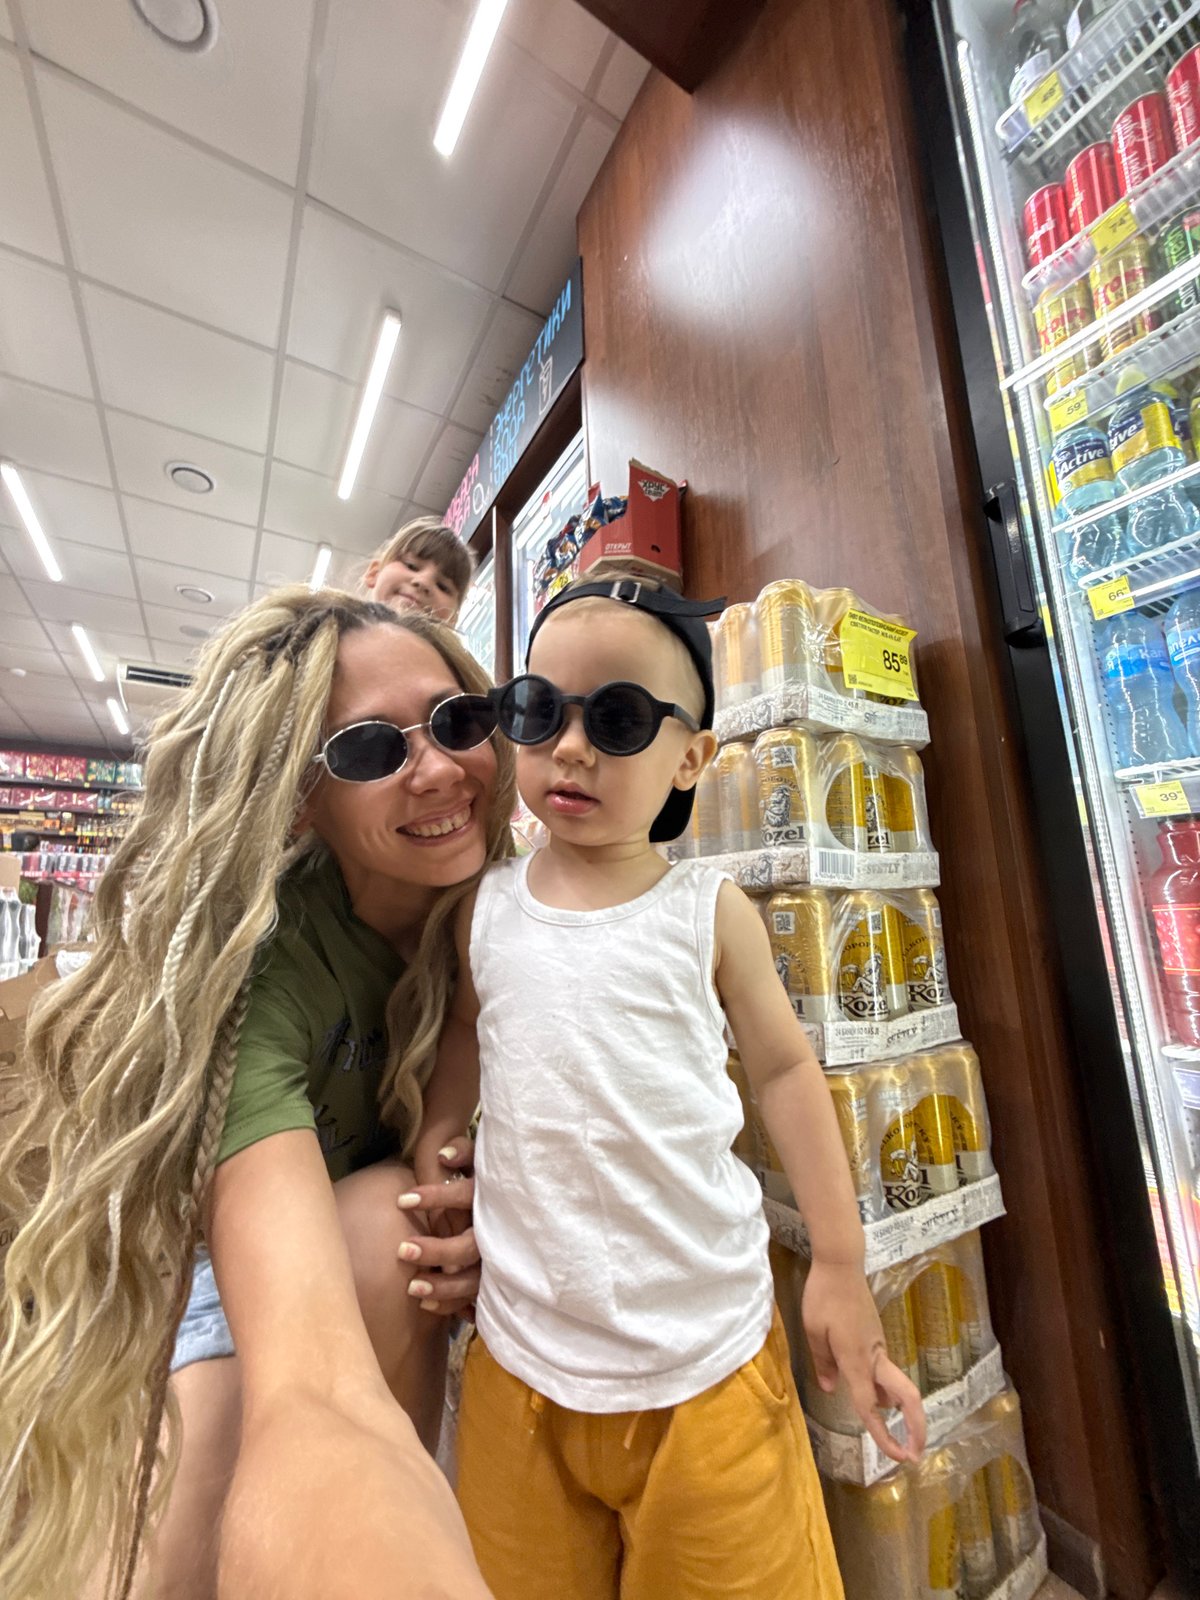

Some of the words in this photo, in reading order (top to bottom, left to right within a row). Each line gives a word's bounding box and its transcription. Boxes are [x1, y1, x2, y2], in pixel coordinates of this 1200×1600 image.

[1066, 402, 1081, 415] 59
[882, 649, 901, 673] 85
[1159, 792, 1178, 802] 39
[867, 831, 890, 849] zel
